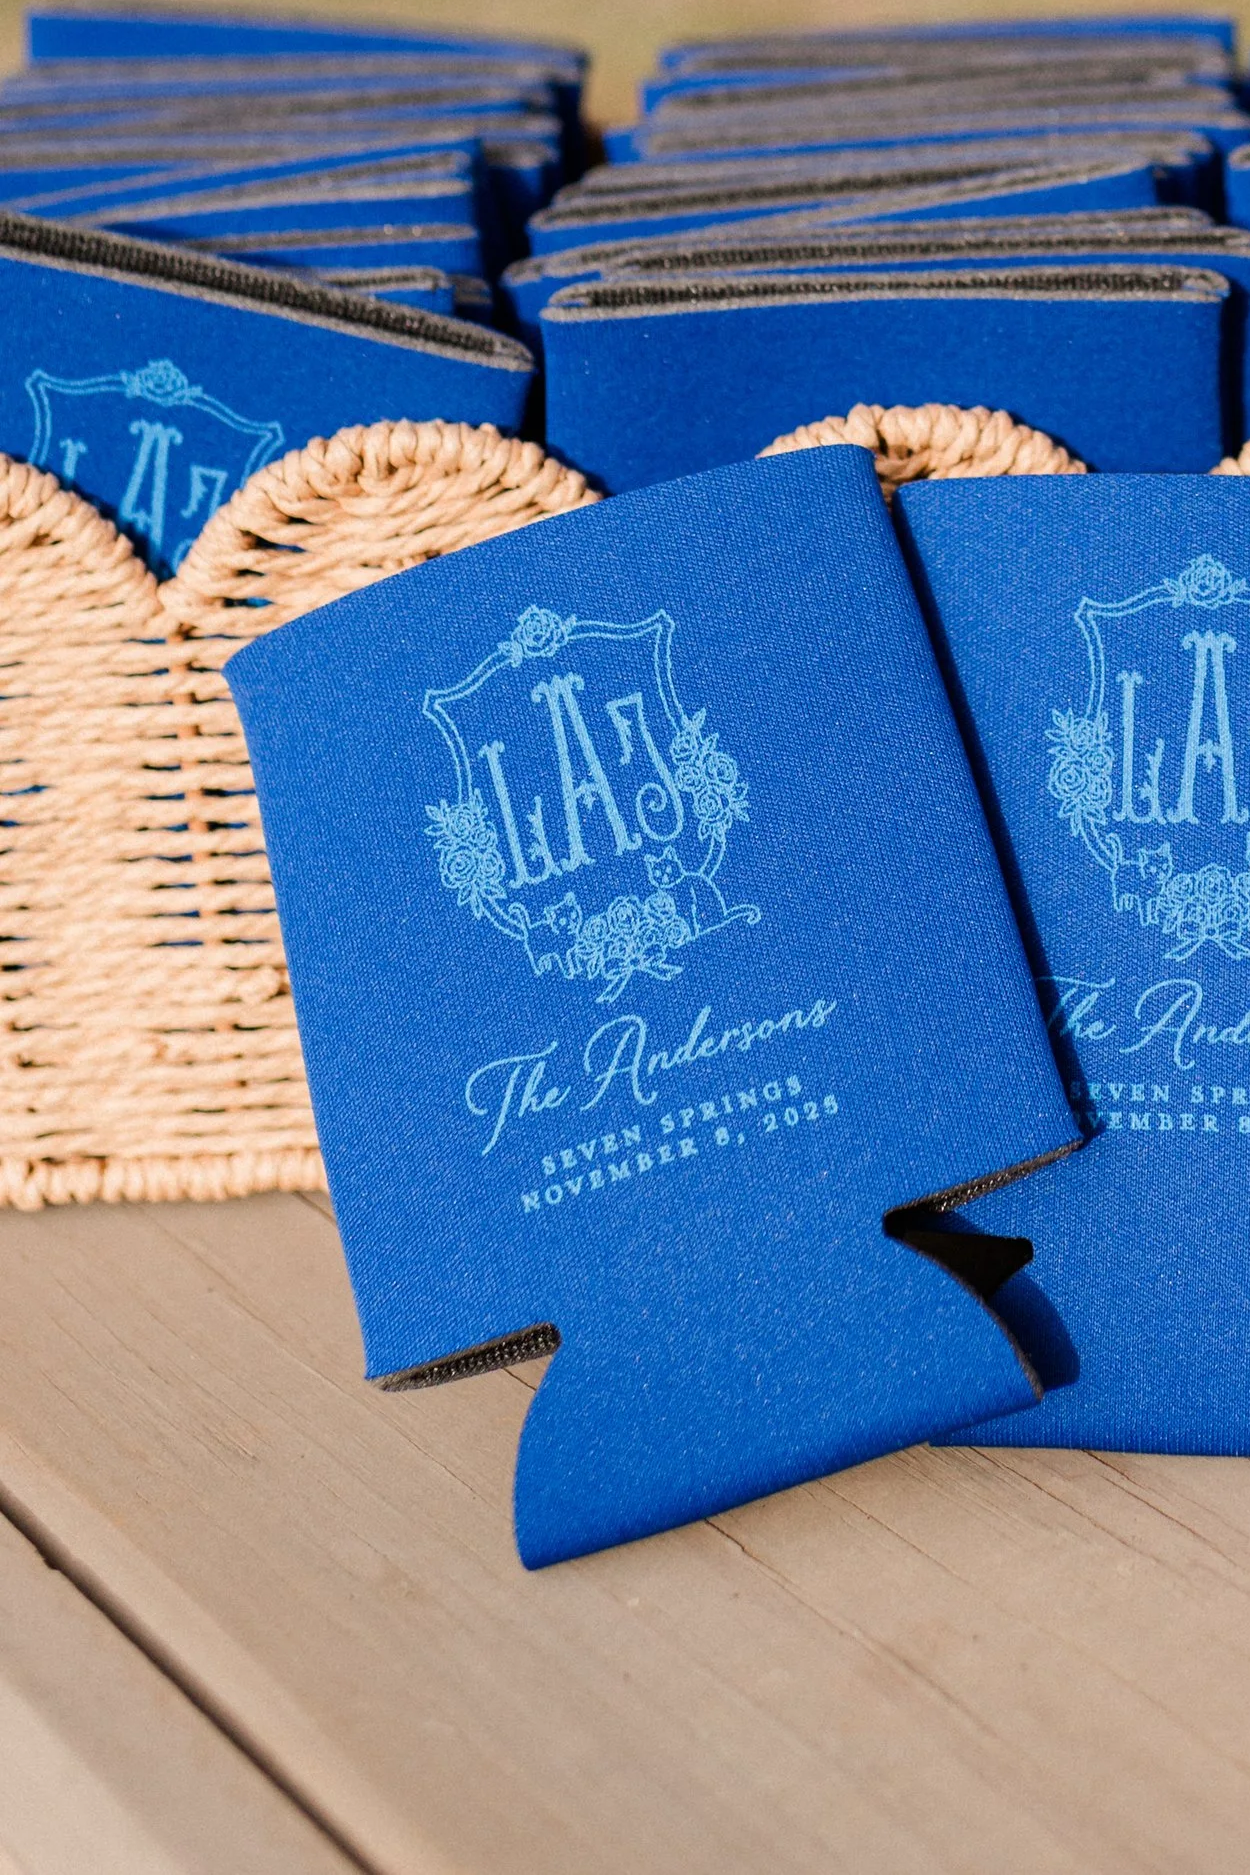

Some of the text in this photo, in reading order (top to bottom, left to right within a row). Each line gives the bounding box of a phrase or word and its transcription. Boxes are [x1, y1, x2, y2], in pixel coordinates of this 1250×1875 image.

[464, 998, 838, 1156] The Andersons
[541, 1074, 801, 1176] SEVEN SPRINGS
[1069, 1080, 1171, 1104] SEVEN
[520, 1093, 839, 1213] NOVEMBER 8, 2025
